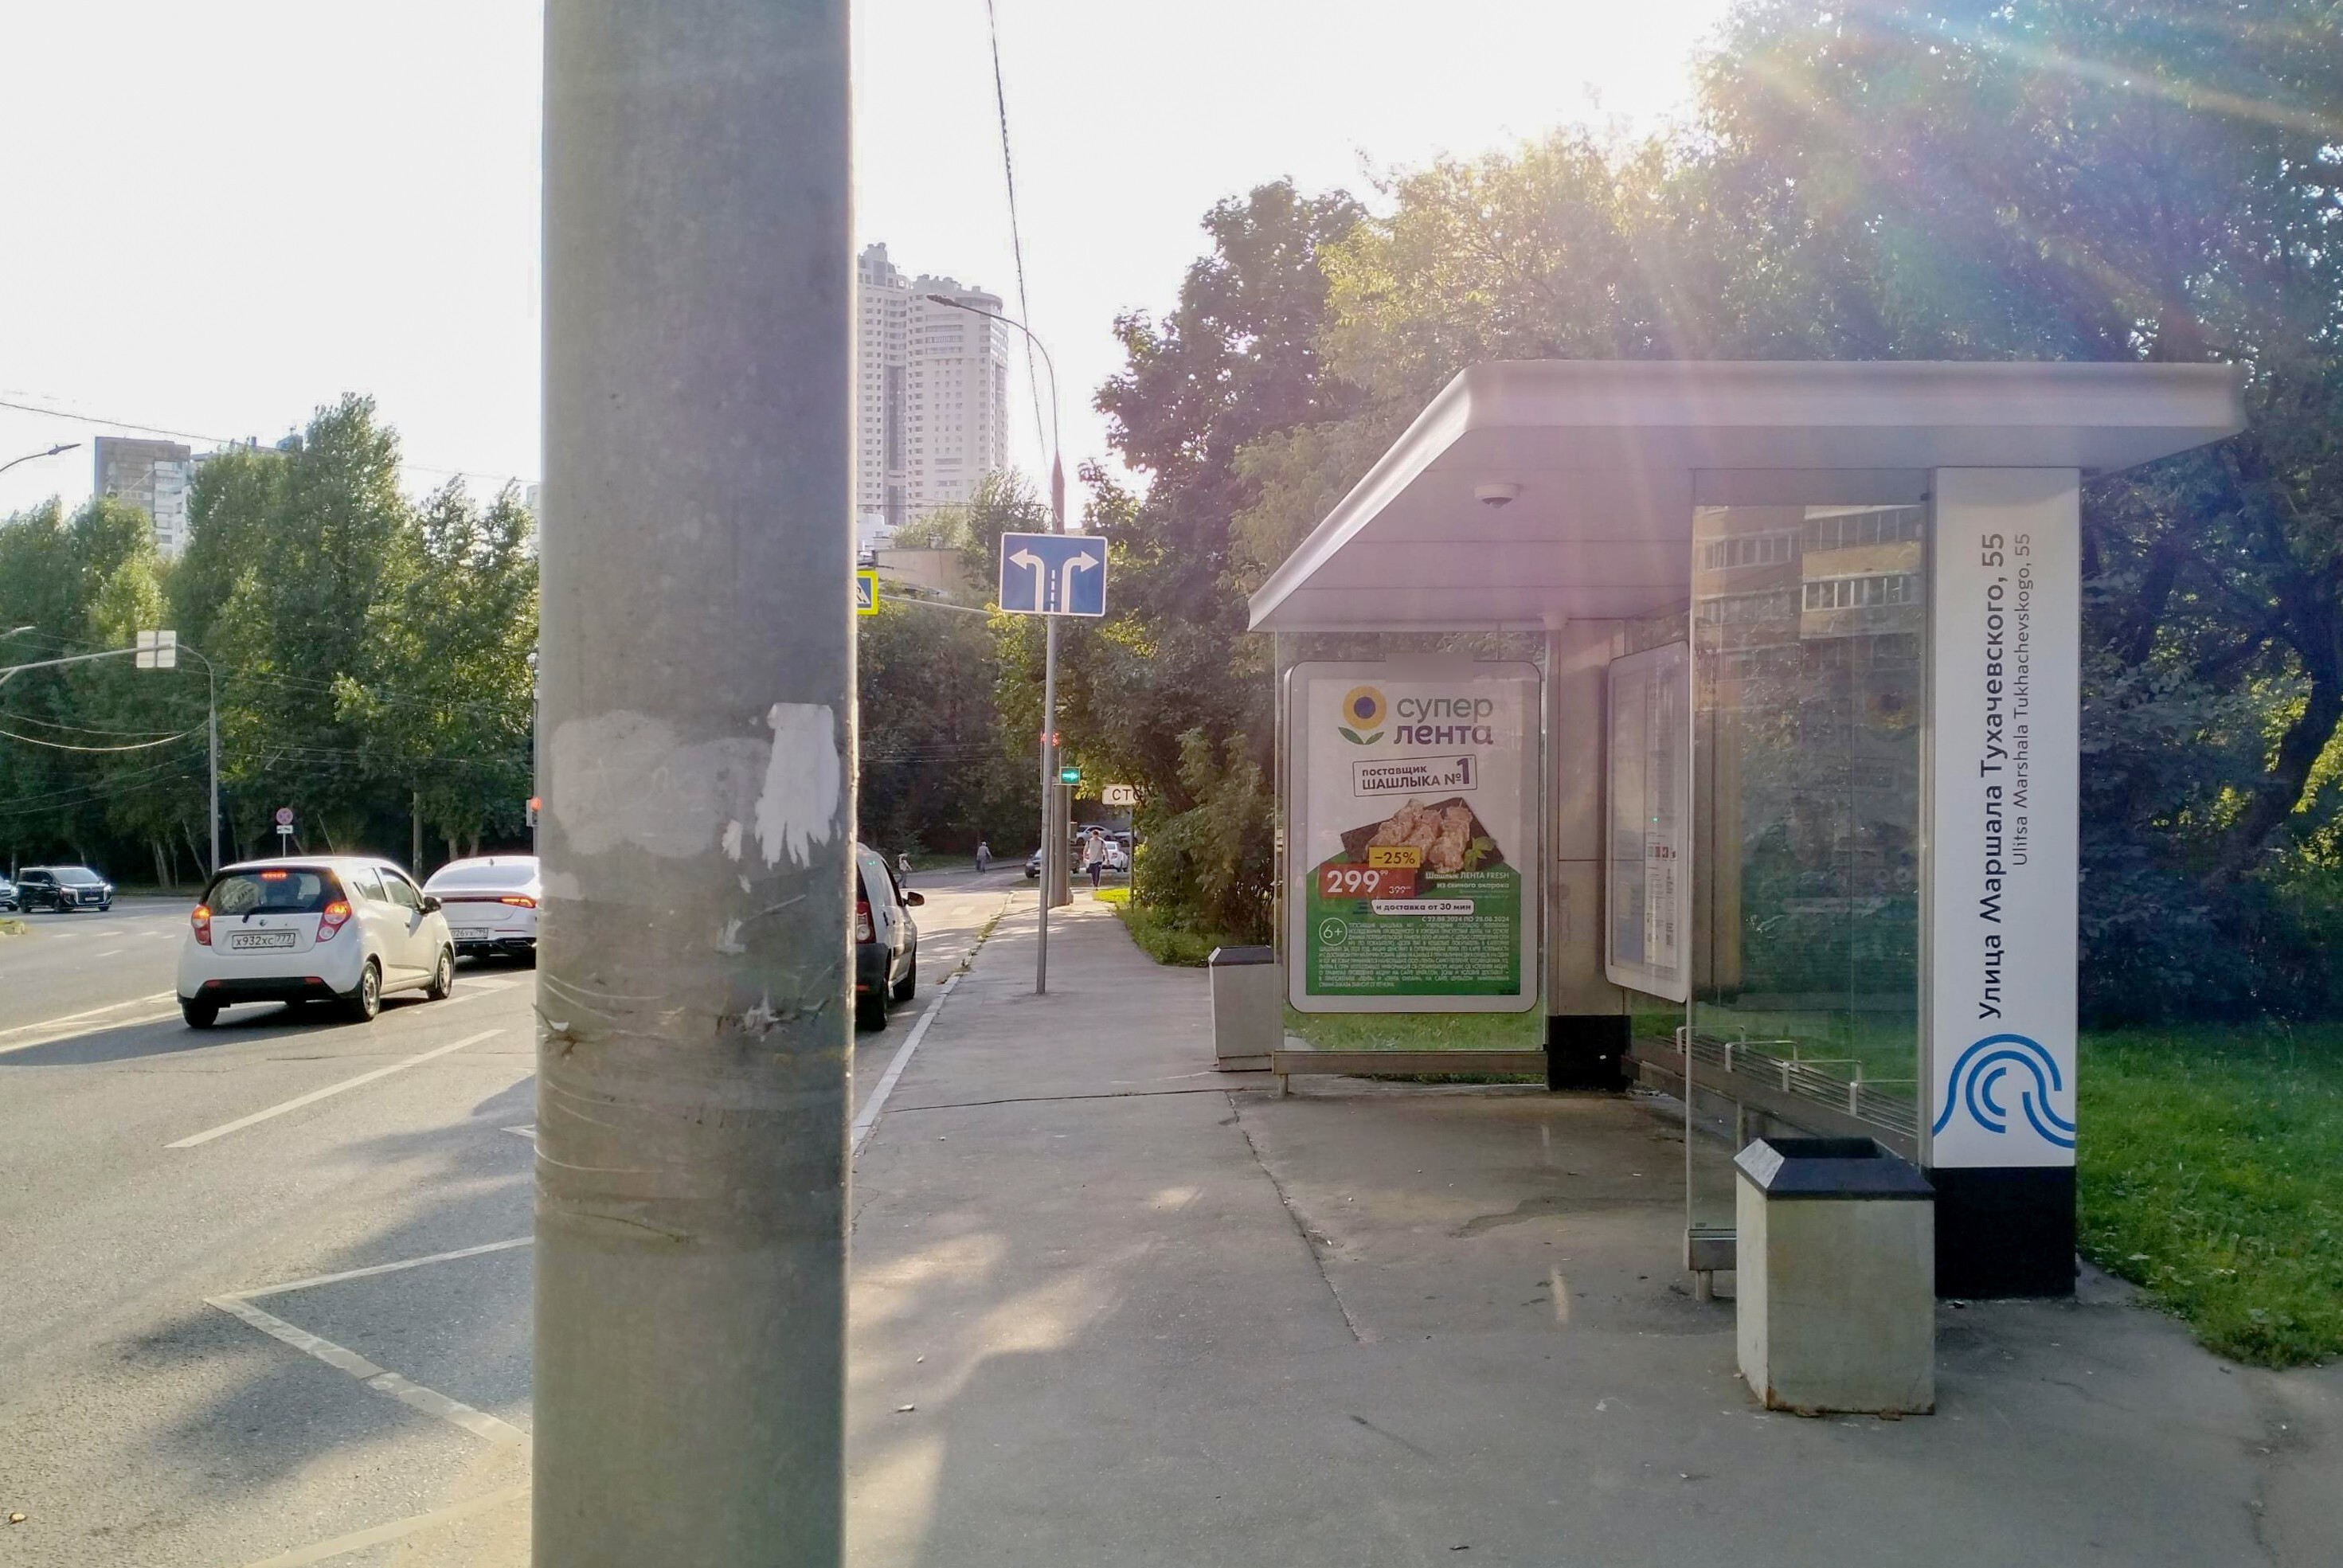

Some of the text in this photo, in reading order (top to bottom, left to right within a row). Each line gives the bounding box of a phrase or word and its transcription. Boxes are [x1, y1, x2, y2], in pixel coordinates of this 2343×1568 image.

[2012, 533, 2034, 866] Ulitsa Marshala Tukhachevskogo, 55
[1397, 698, 1493, 723] супер
[1394, 725, 1494, 745] лента
[1362, 765, 1427, 776] поставщик
[1979, 533, 2009, 1019] Улица Маршала Тухачевского, 55
[1362, 775, 1440, 790] ШАШЛЫКА
[1327, 870, 1379, 893] 299
[1323, 925, 1343, 939] 6+
